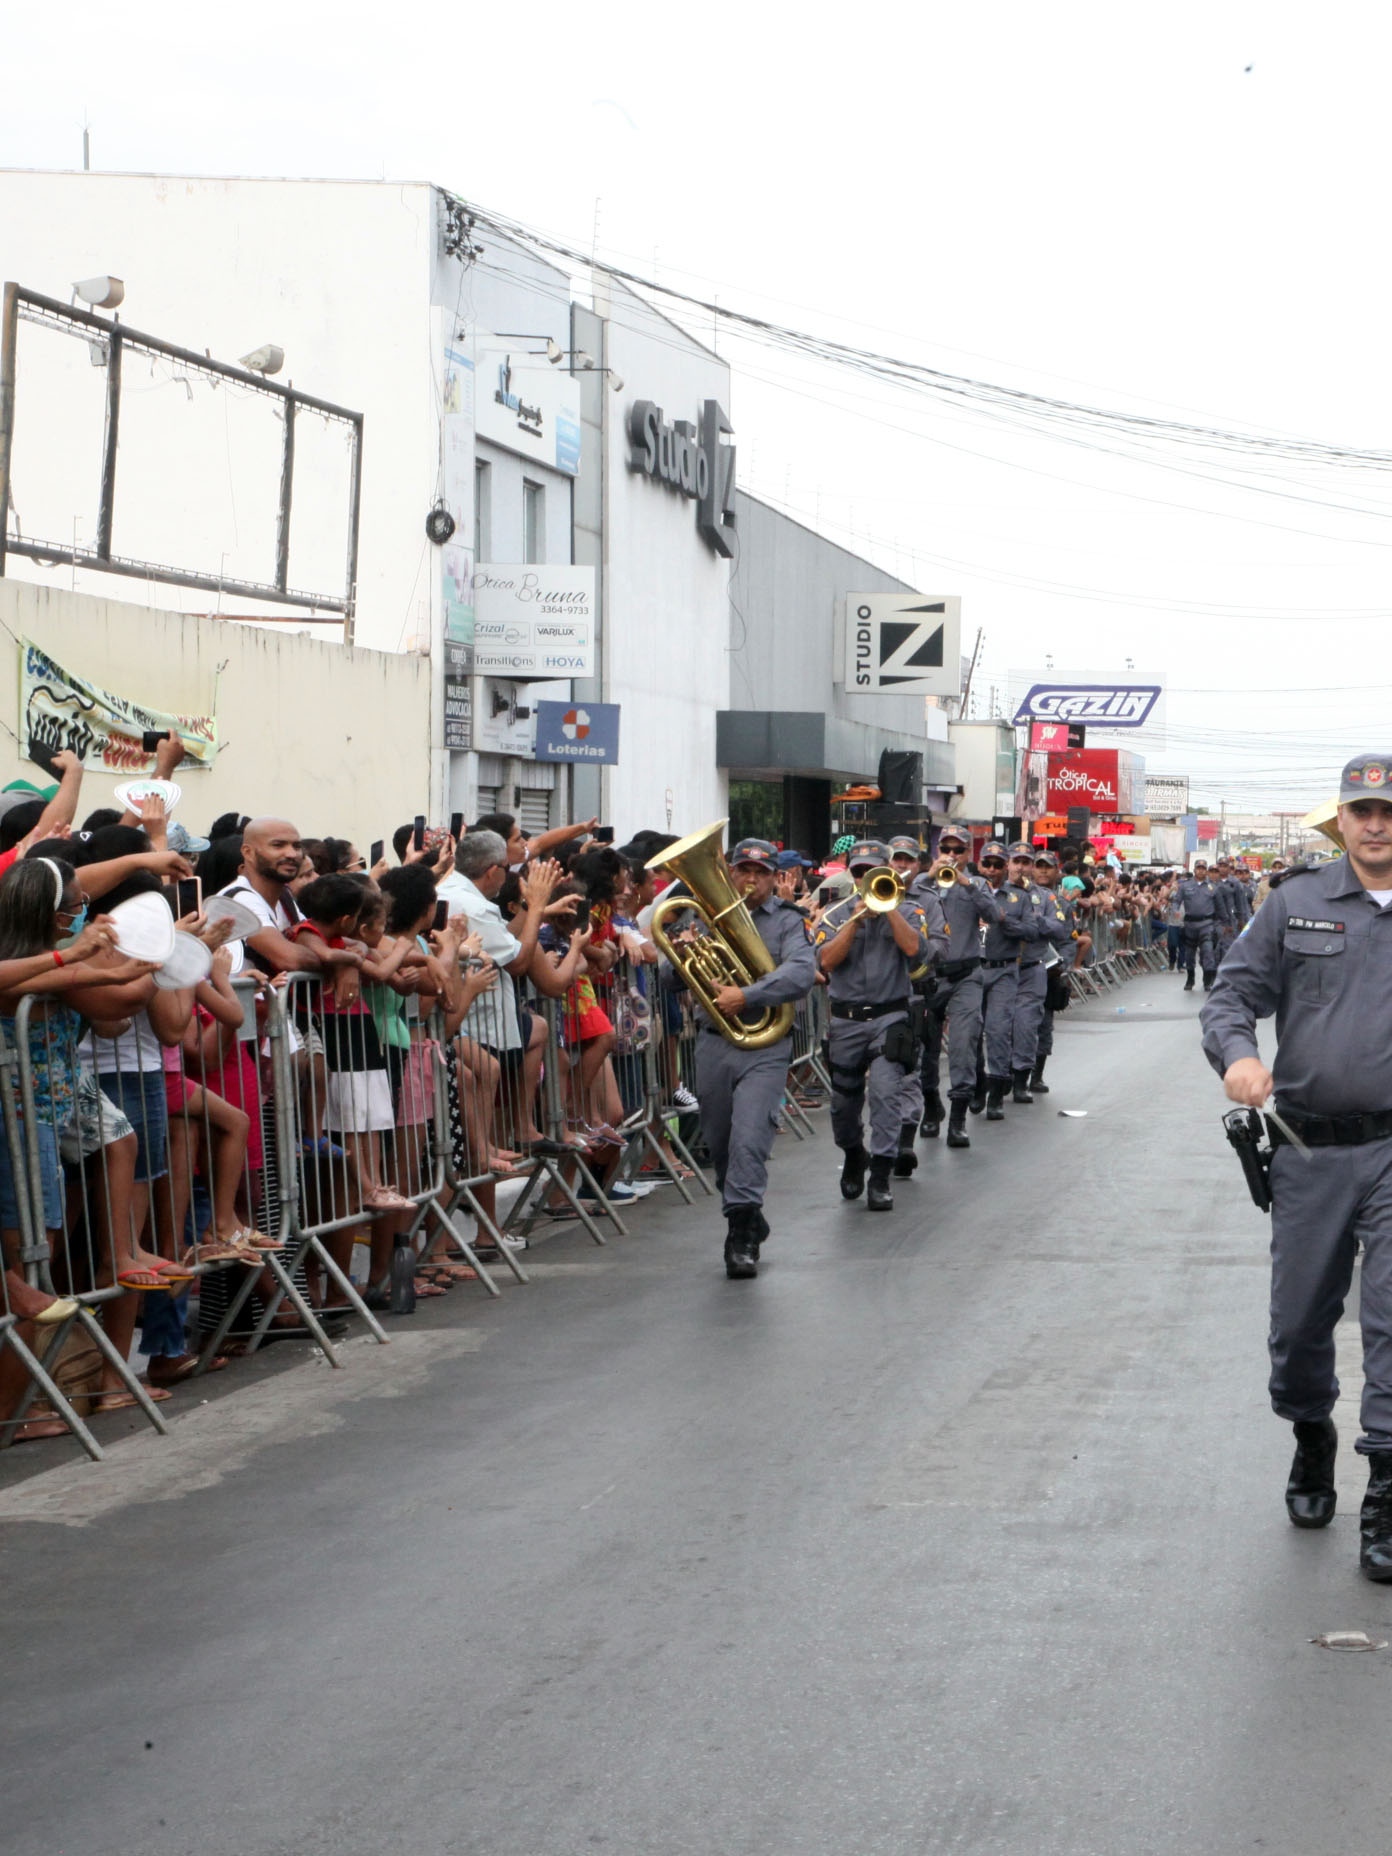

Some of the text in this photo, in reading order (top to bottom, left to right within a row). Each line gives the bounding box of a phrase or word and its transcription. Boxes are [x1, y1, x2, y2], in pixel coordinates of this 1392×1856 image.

[514, 573, 588, 602] Bruna
[540, 605, 589, 615] 3364-9733
[473, 623, 505, 633] Crizal
[536, 628, 575, 637] VARILUX
[856, 604, 872, 686] STUDIO
[545, 657, 585, 667] HOYA
[1029, 690, 1155, 720] GAZIN
[548, 742, 606, 757] Loterias
[1059, 767, 1087, 781] Ótica
[1048, 778, 1116, 796] TROPICAL
